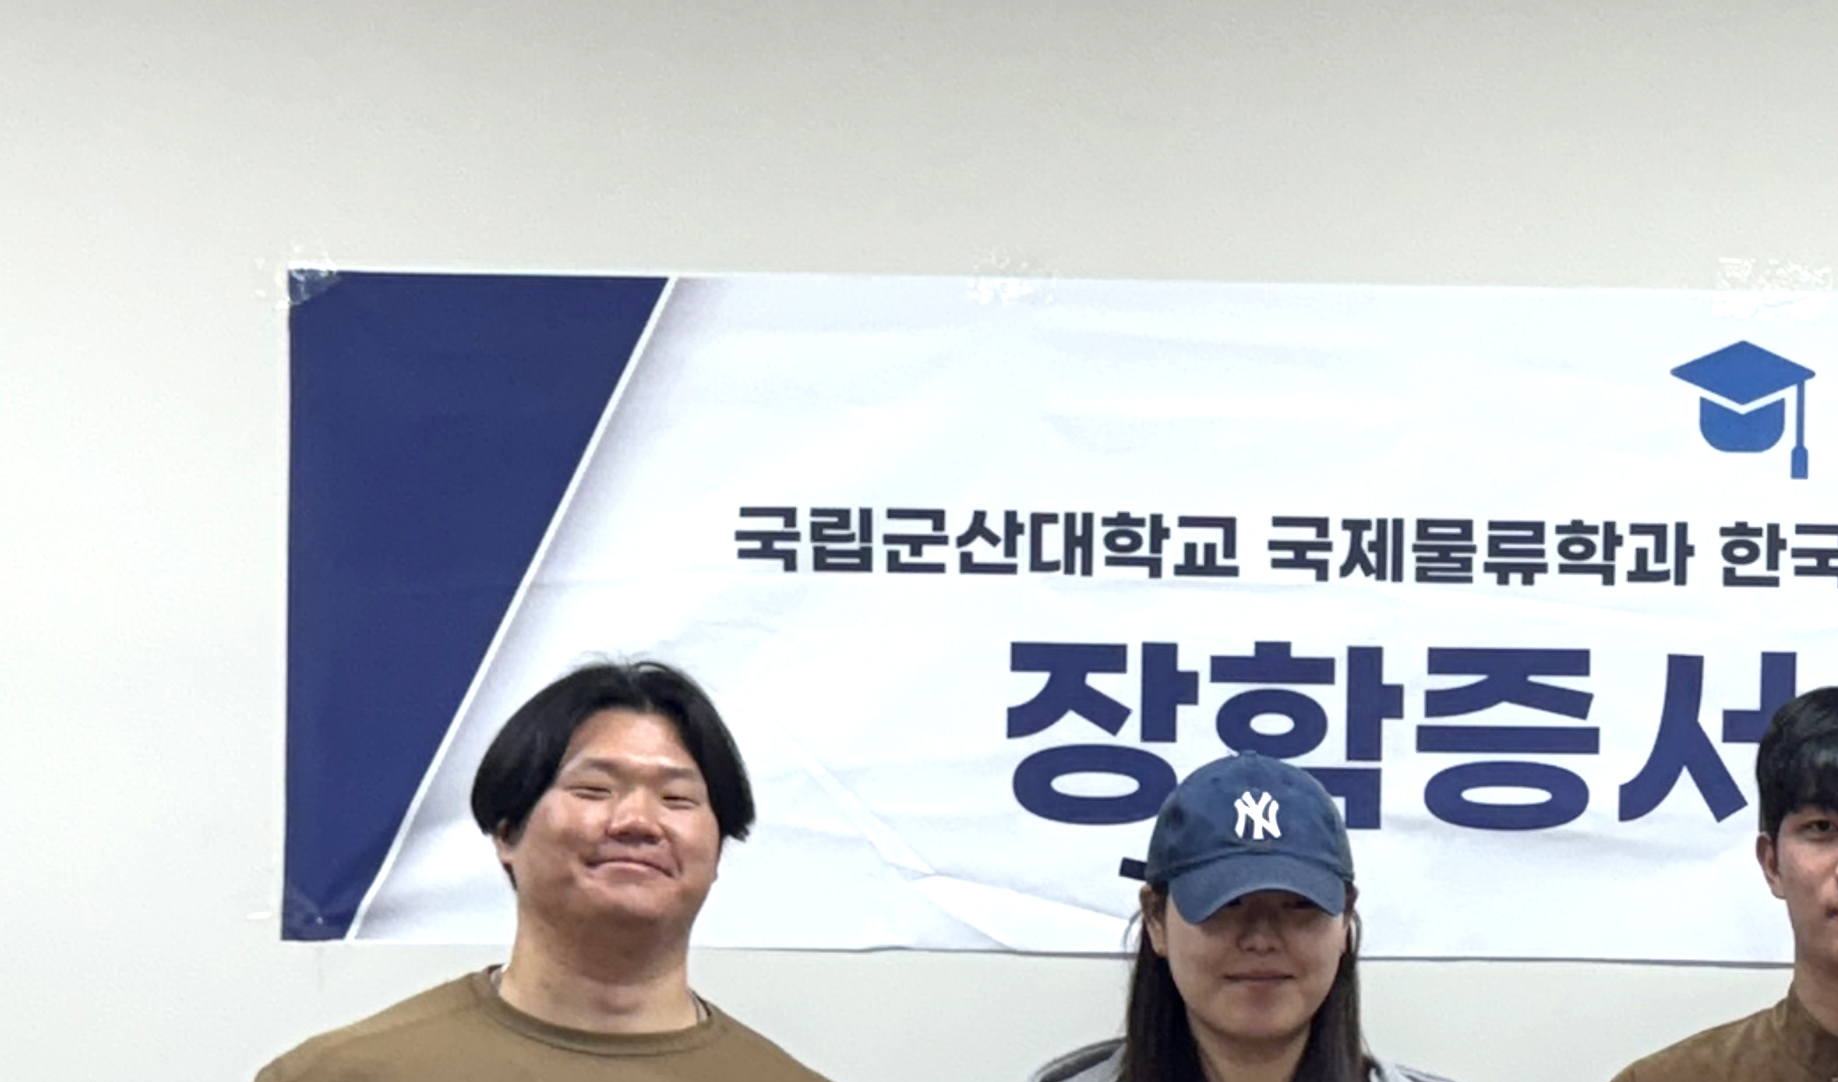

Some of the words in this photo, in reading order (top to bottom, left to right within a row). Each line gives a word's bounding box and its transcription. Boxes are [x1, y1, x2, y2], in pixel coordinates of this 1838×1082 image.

[734, 507, 1239, 579] 국립군산대학교
[1267, 516, 1695, 587] 국제물류학과
[1006, 641, 1798, 831] 장학증서
[1234, 791, 1281, 839] NY
